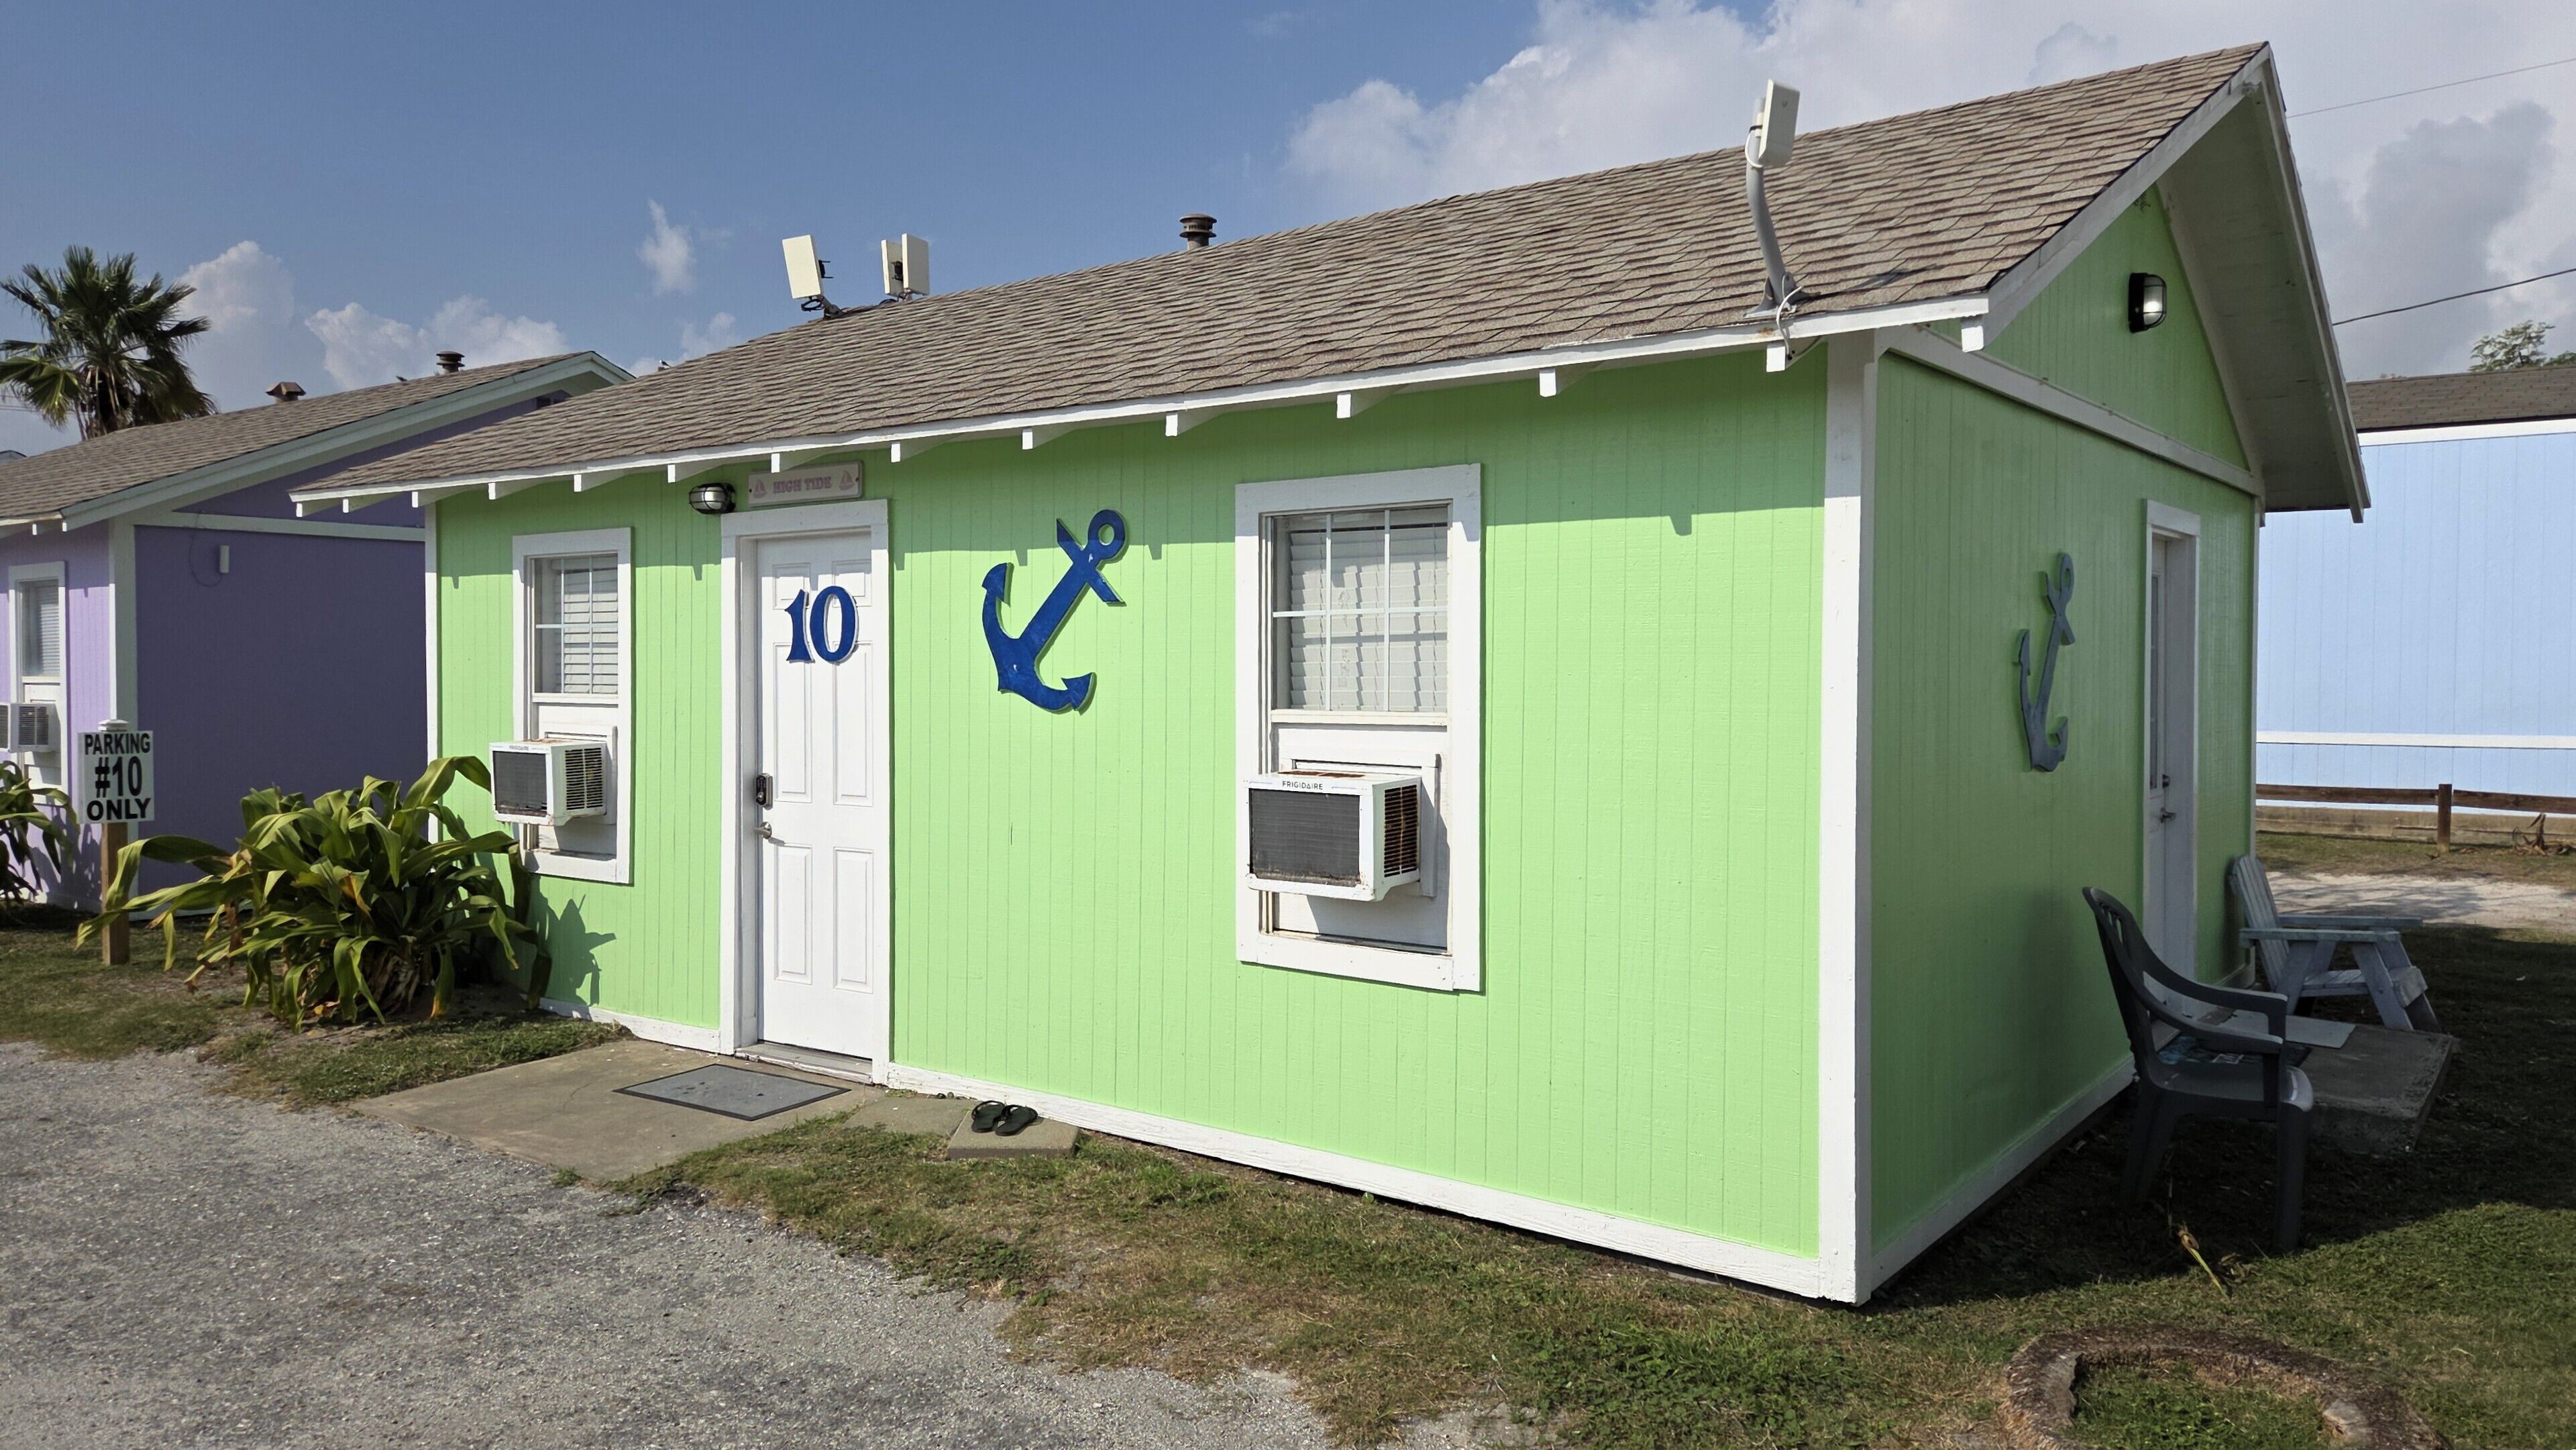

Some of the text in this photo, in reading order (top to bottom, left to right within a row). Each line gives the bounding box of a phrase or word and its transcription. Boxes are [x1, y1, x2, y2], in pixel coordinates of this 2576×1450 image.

[773, 476, 832, 494] HIGH TIDE
[784, 585, 859, 663] 10
[85, 733, 150, 755] PARKING
[95, 756, 143, 798] #10
[1282, 780, 1324, 790] FRIGIDAIRE
[87, 798, 151, 821] ONLY
